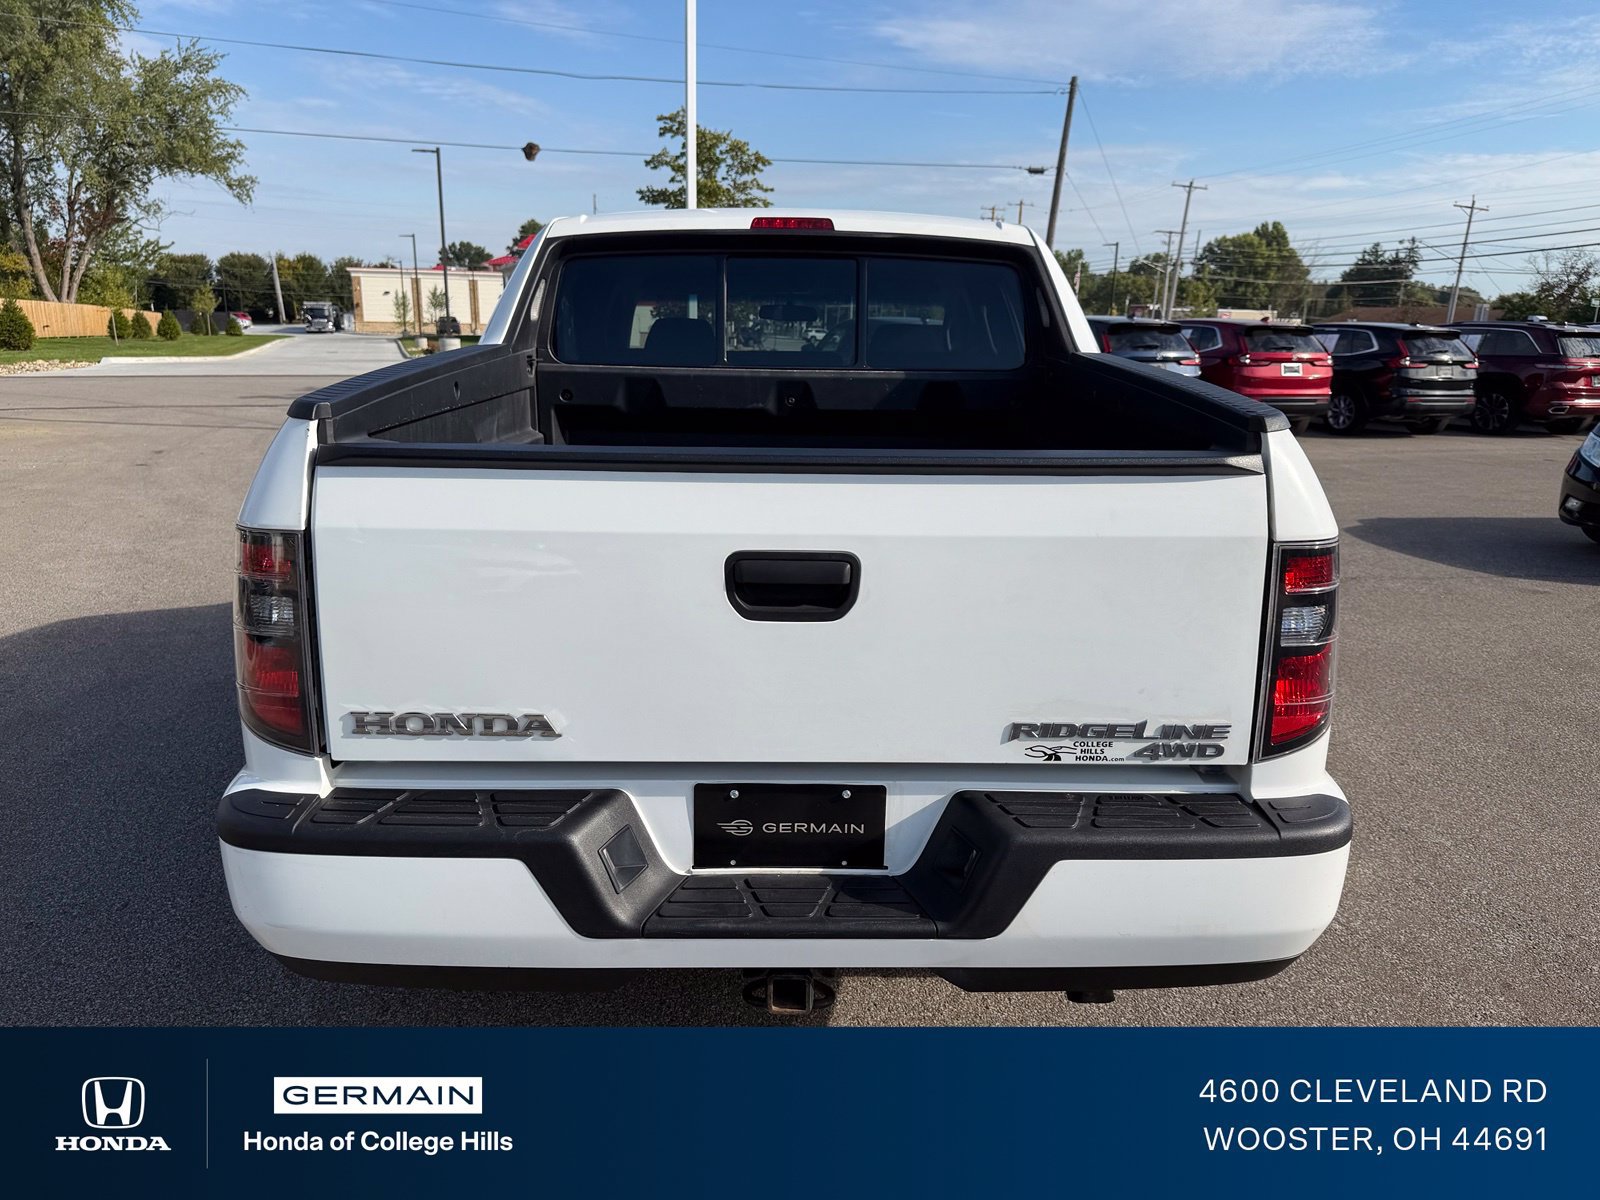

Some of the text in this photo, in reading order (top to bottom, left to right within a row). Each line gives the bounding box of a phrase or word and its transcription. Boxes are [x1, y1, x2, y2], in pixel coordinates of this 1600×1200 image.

[346, 711, 563, 738] HONDA
[1006, 719, 1232, 742] RIDGELINE
[1073, 740, 1114, 748] COLLEGE
[1132, 743, 1226, 760] 4WD
[762, 822, 865, 834] GERMAIN
